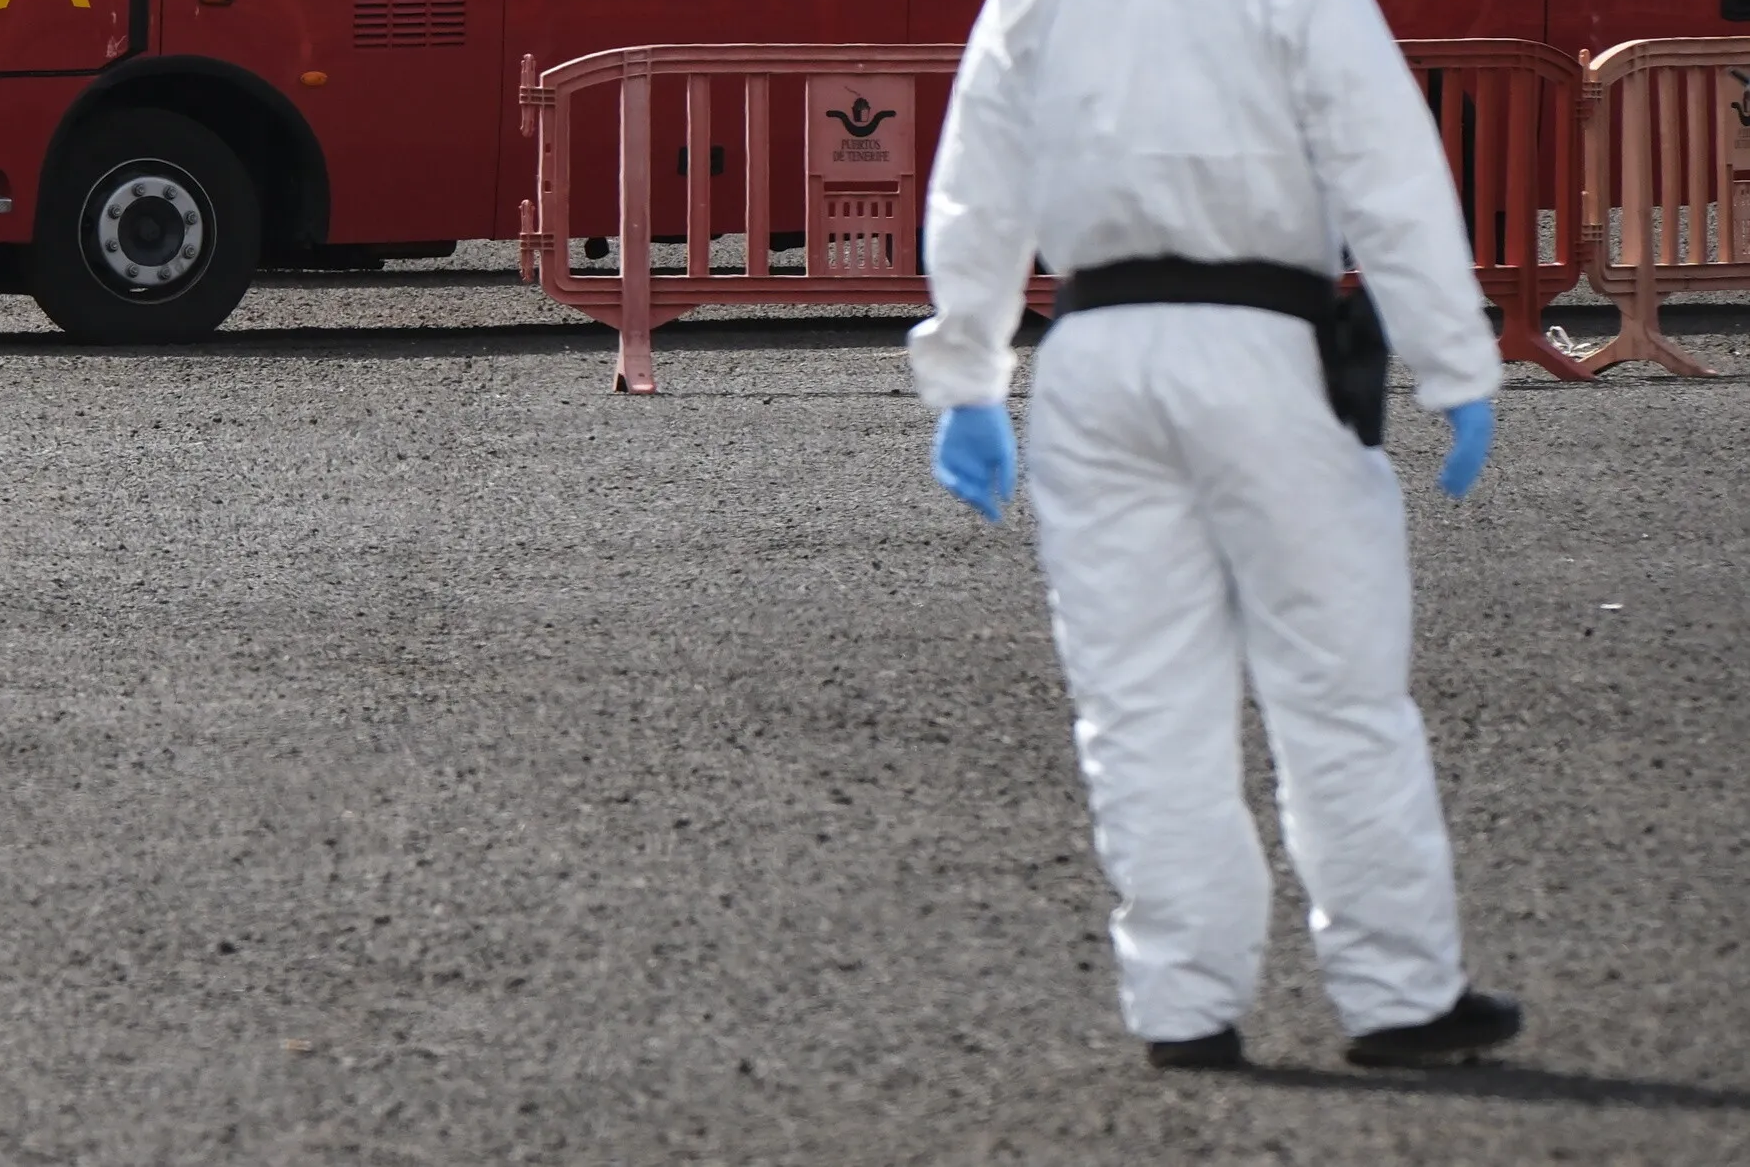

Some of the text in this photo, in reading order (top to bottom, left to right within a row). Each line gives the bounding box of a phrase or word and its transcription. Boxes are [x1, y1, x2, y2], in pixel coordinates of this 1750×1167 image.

[841, 139, 881, 150] PUERTOS
[833, 150, 890, 162] DE TENERIFE
